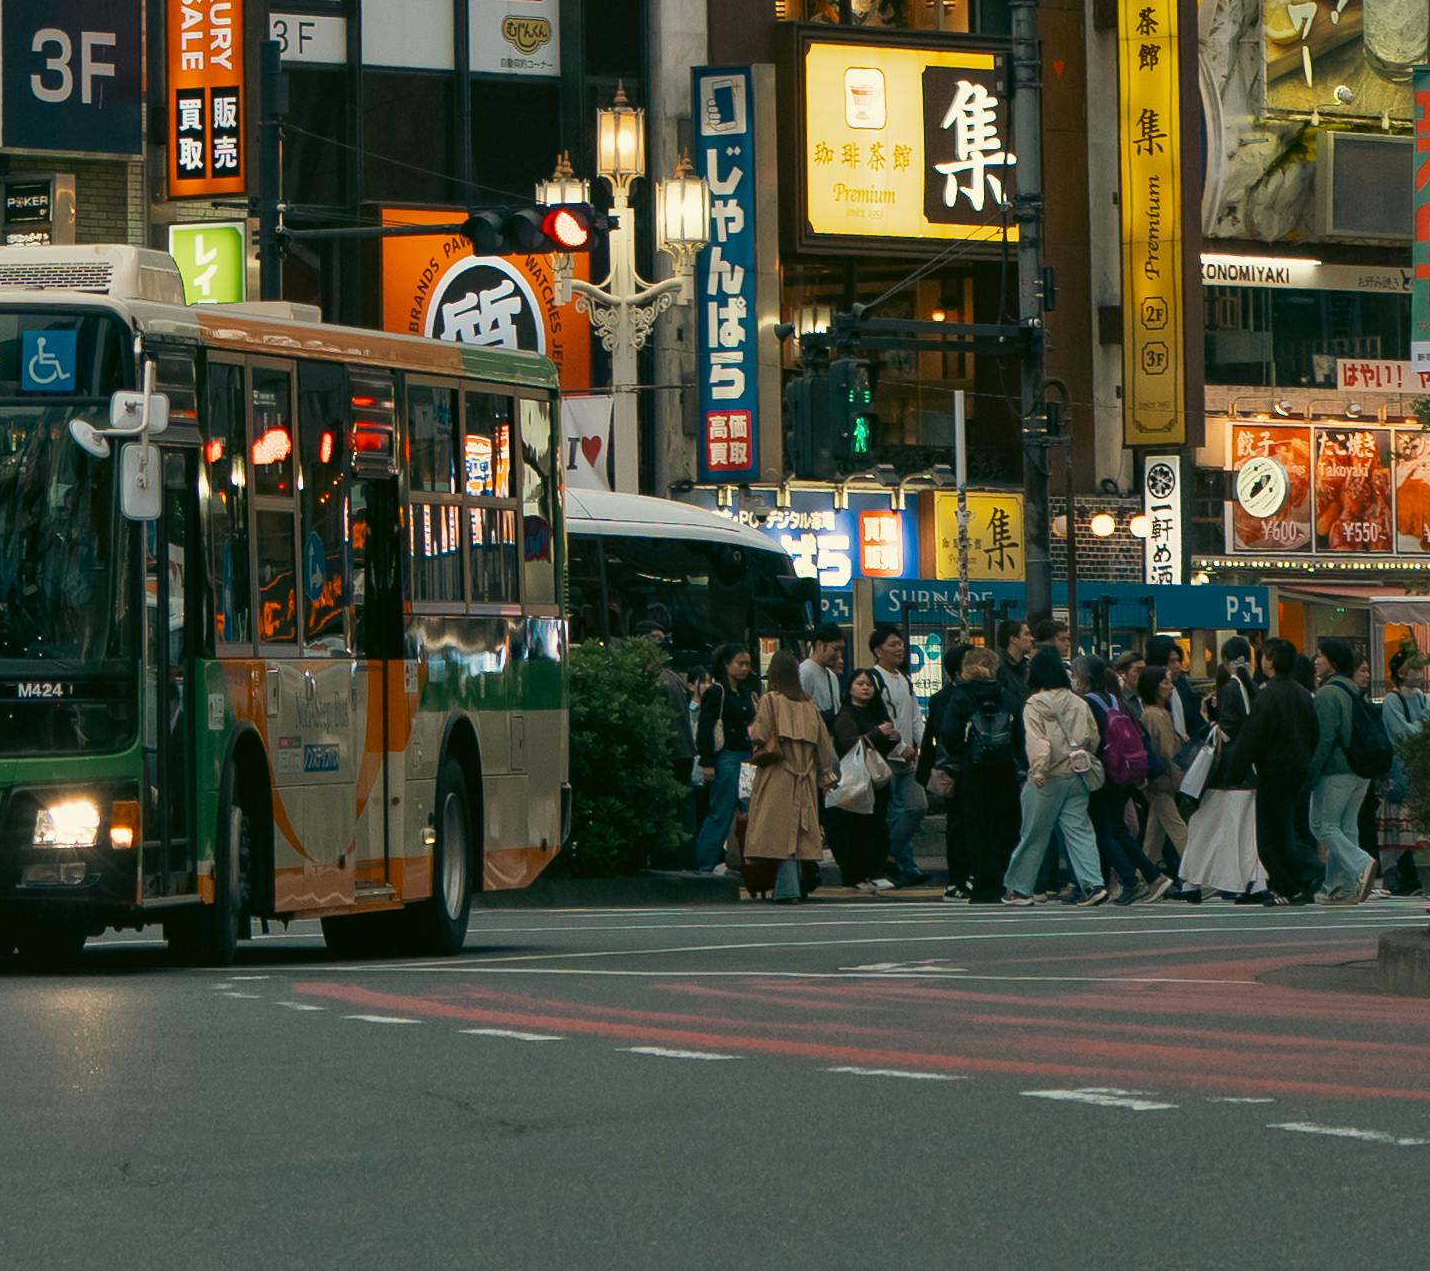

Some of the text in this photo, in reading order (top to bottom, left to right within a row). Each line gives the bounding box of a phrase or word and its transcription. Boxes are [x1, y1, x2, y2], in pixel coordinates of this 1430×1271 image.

[29, 27, 117, 106] 3F
[273, 17, 314, 55] 3F
[179, 97, 204, 172] 買取
[212, 95, 238, 169] 販売
[813, 141, 914, 172] 珈琲茶館
[935, 79, 1017, 214] 集
[1132, 107, 1168, 157] 集
[832, 182, 897, 206] Premium
[1145, 174, 1161, 280] Premium
[408, 257, 441, 333] BRANDS
[524, 254, 563, 332] WATCHES
[705, 146, 746, 400] じゃんぱら
[1318, 431, 1378, 458] たこ焼き
[1319, 464, 1371, 479] Takoyaki
[18, 683, 63, 698] M424
